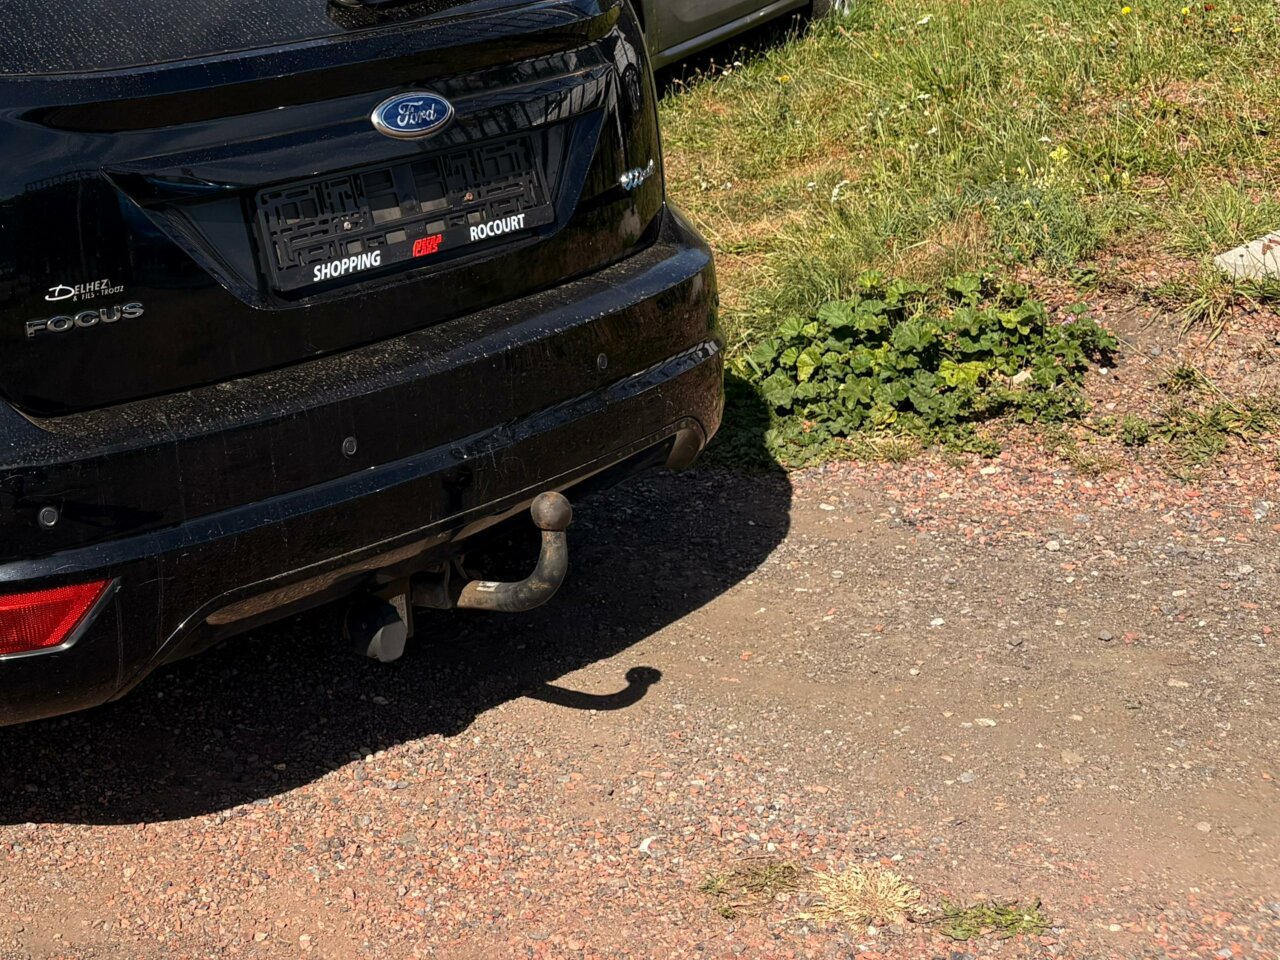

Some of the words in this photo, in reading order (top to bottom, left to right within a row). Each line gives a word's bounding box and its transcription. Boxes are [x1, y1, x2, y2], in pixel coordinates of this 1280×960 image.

[313, 250, 381, 282] SHOPPING
[470, 214, 525, 241] ROCOURT
[81, 291, 95, 300] FILS
[25, 302, 145, 337] FOCUS
